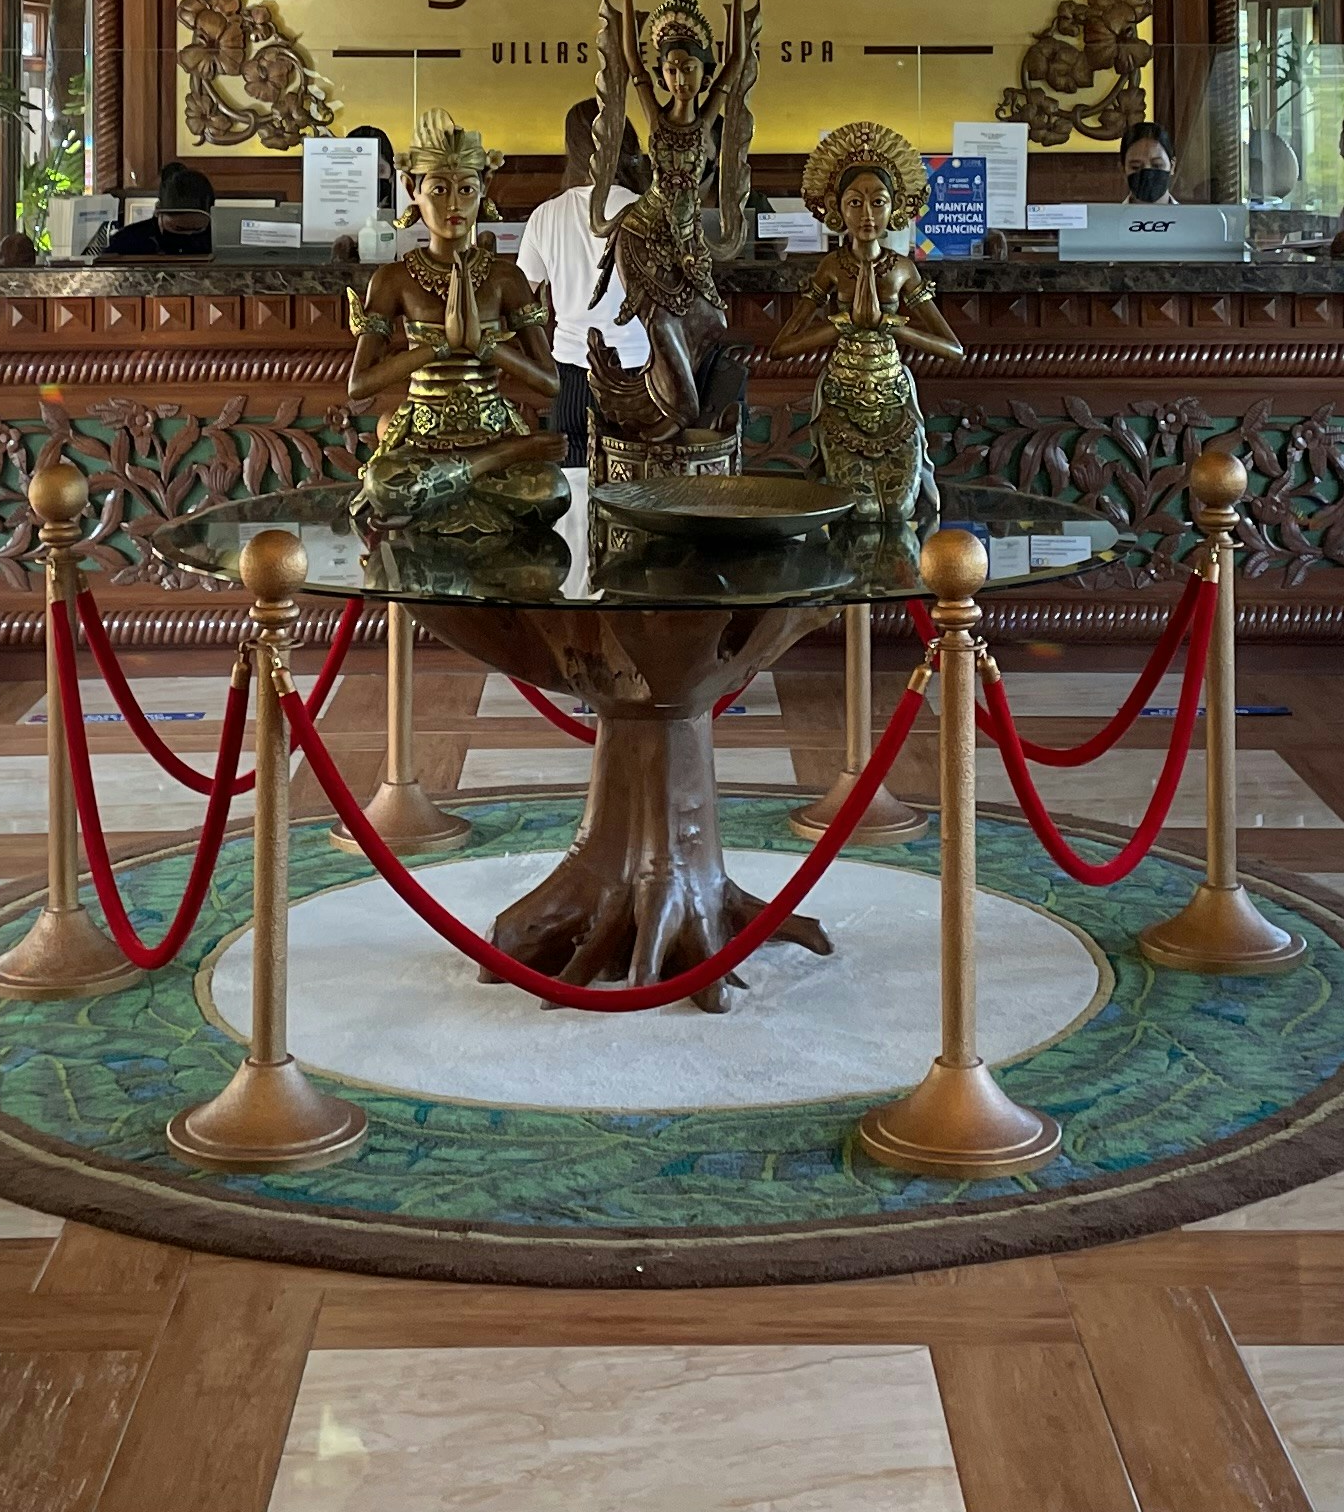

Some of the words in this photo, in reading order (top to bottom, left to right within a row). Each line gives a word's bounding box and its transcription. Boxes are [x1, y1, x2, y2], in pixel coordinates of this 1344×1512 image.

[492, 41, 589, 64] VILLAS
[780, 40, 834, 63] SPA
[935, 202, 984, 212] MAINTAIN
[938, 213, 984, 223] PHYSICAL
[924, 224, 984, 234] DISTANCING
[1128, 220, 1176, 232] acer
